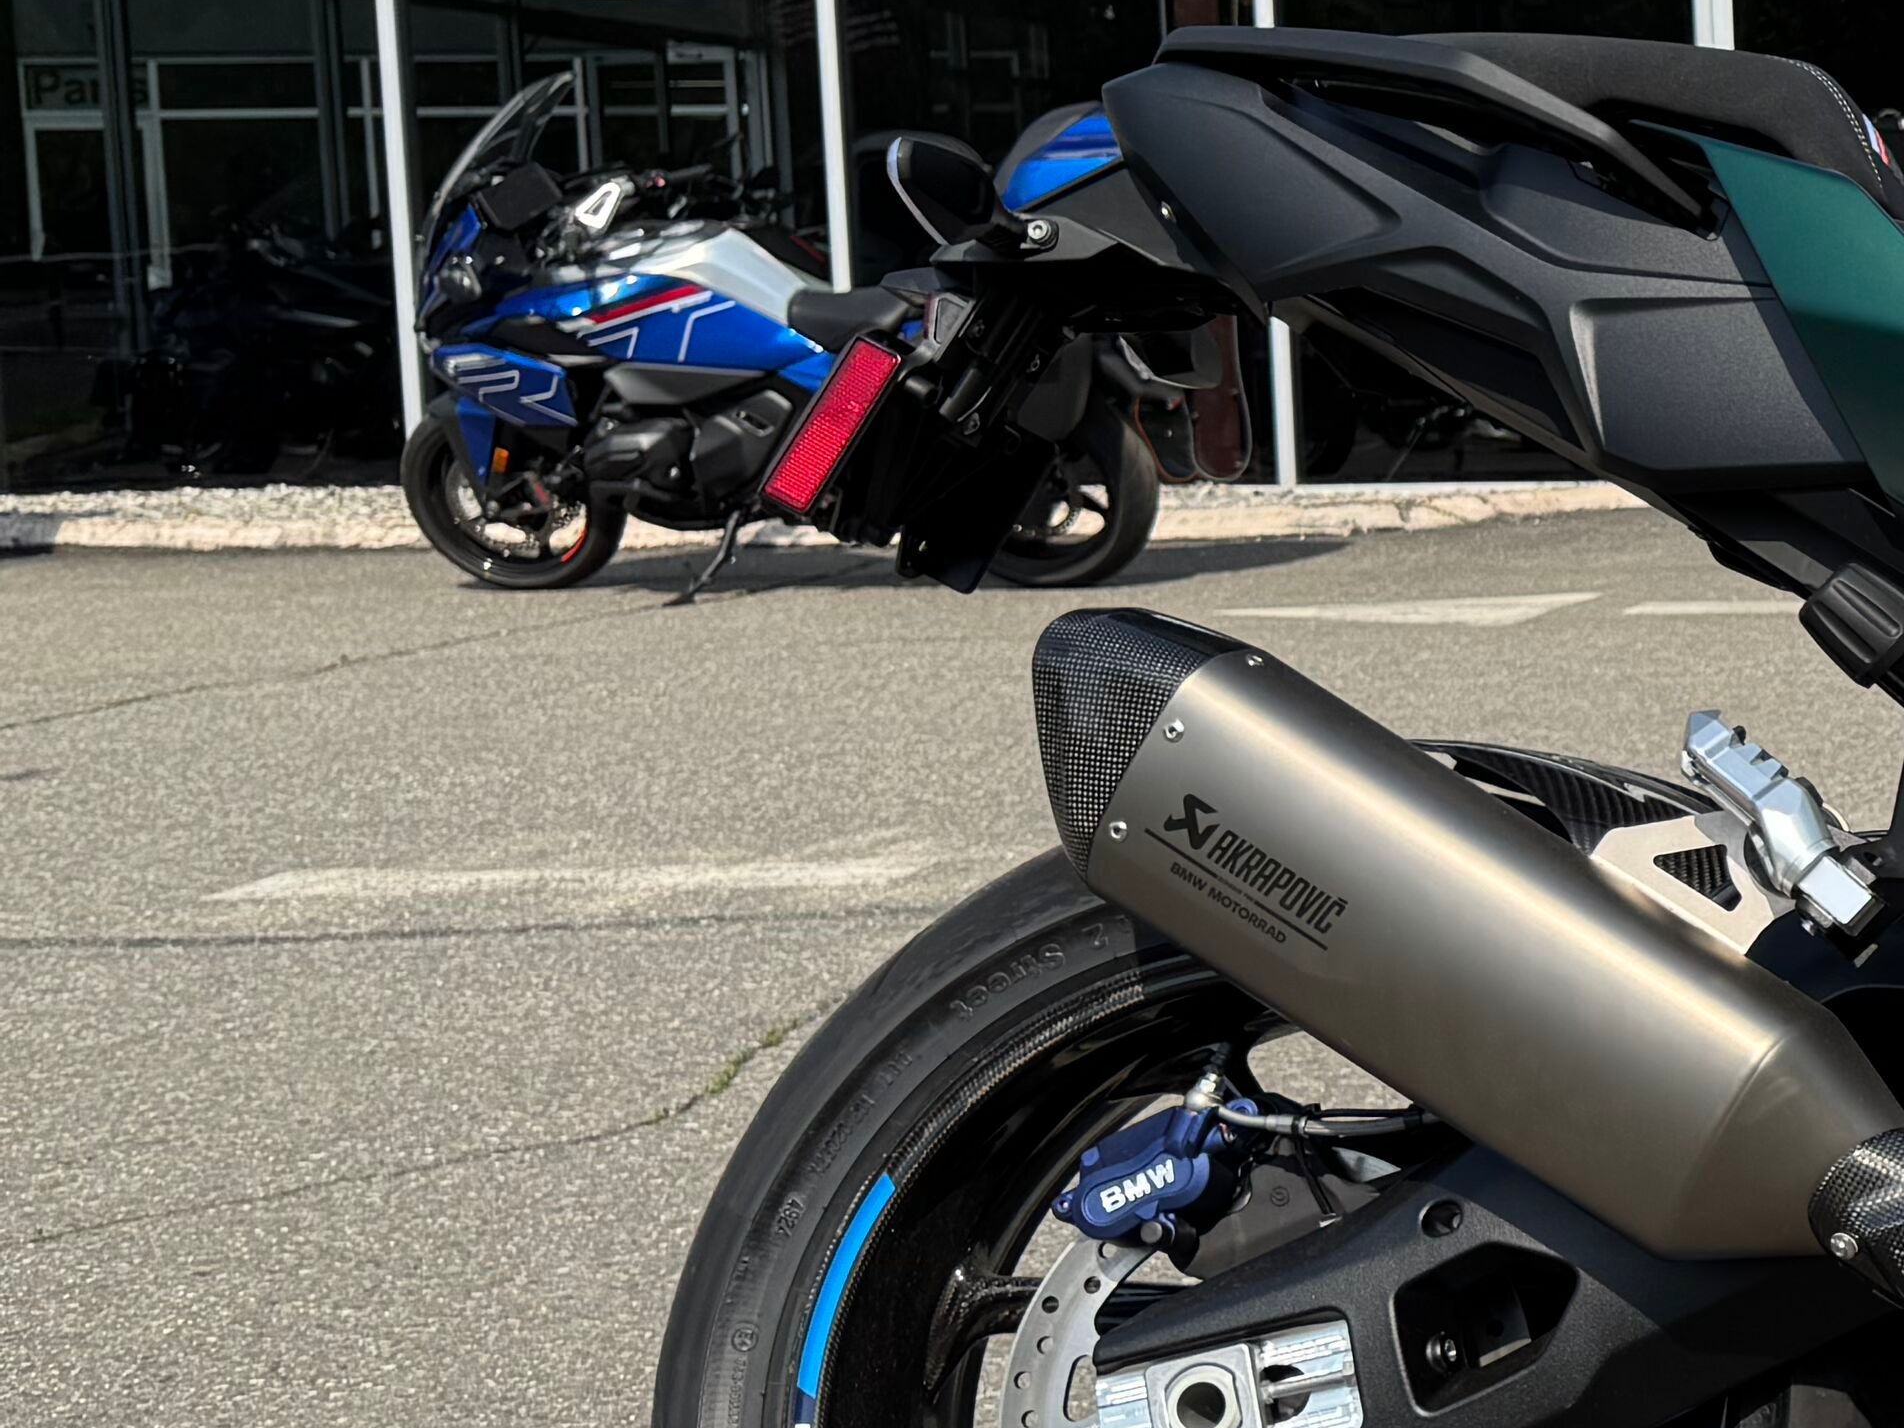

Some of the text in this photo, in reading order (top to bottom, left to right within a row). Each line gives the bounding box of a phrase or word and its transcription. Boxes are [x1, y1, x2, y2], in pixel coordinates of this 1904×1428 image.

[1170, 862, 1207, 891] BMW
[1208, 887, 1287, 944] MOTORRAD
[1206, 830, 1348, 934] AKRAPOVIČ
[1100, 1159, 1175, 1213] BMW
